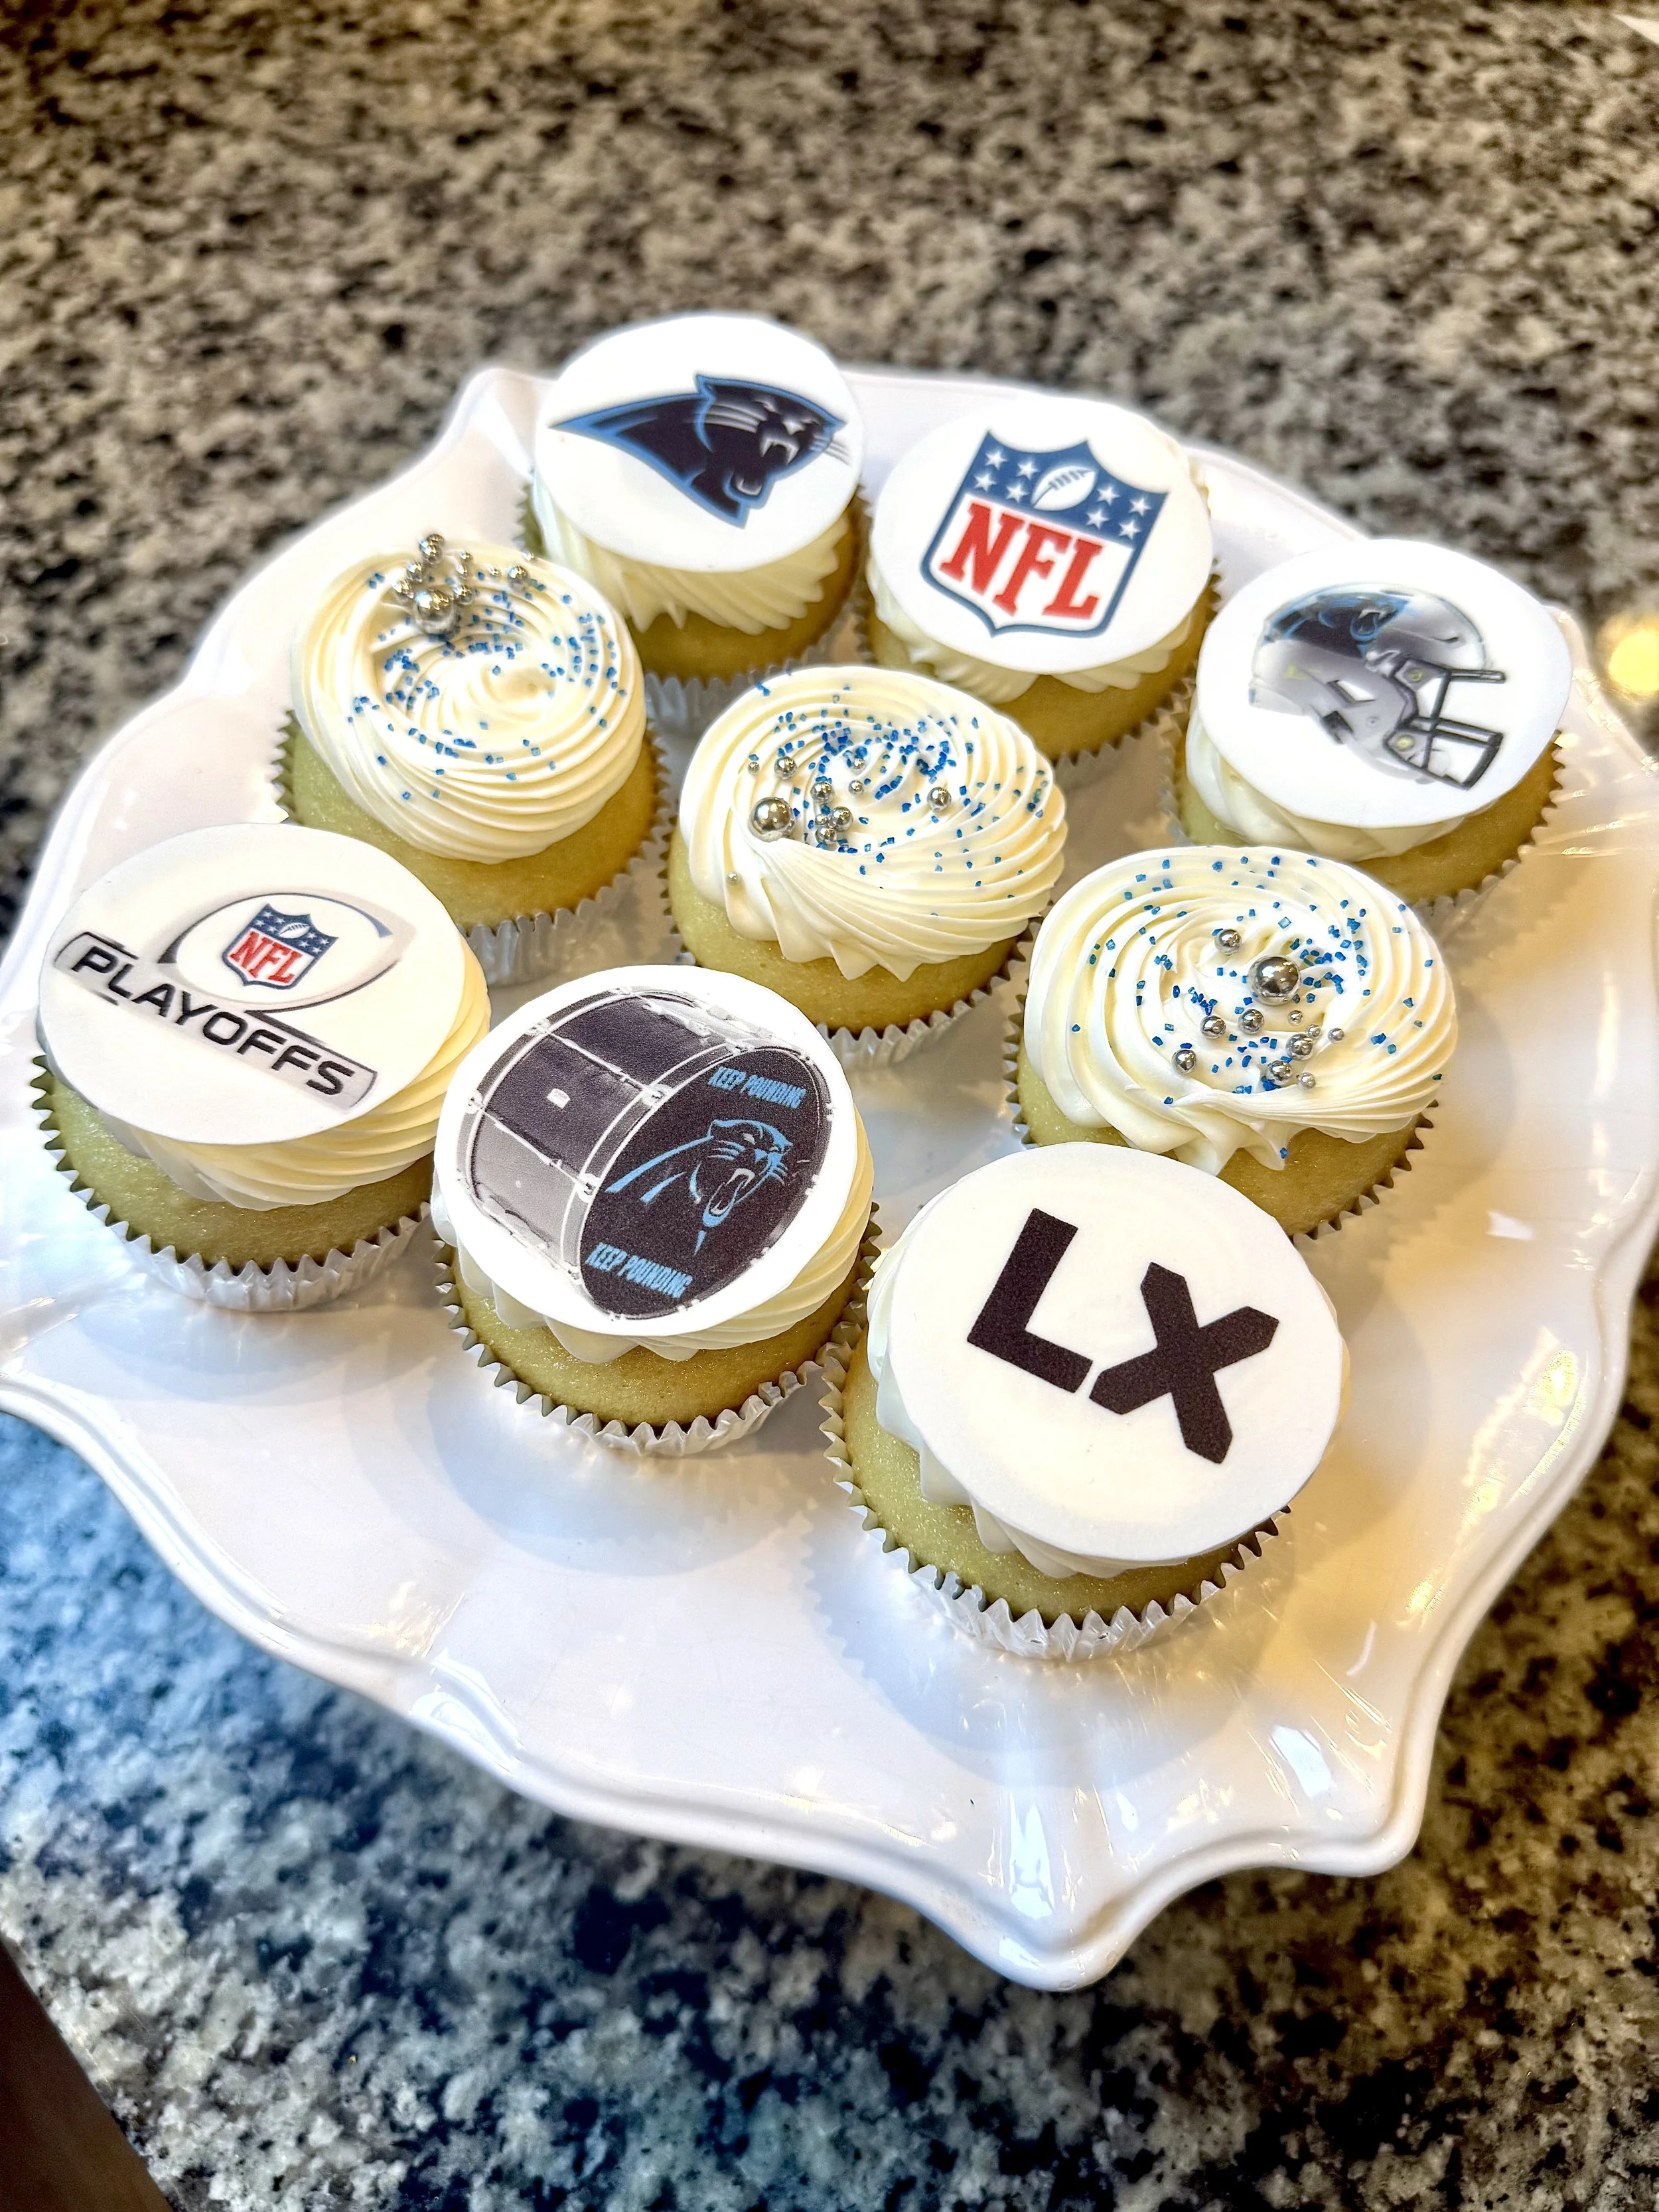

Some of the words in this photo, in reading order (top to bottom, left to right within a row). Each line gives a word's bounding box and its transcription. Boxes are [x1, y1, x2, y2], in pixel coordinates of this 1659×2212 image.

[939, 500, 1104, 620] NFL
[230, 931, 303, 984] NFL
[71, 946, 354, 1096] PLAYOFFS
[707, 1066, 747, 1090] KEEP
[739, 1074, 808, 1109] POUNDING
[585, 1242, 628, 1272] KEEP
[616, 1255, 693, 1299] POUNDING
[967, 1208, 1279, 1464] LX
